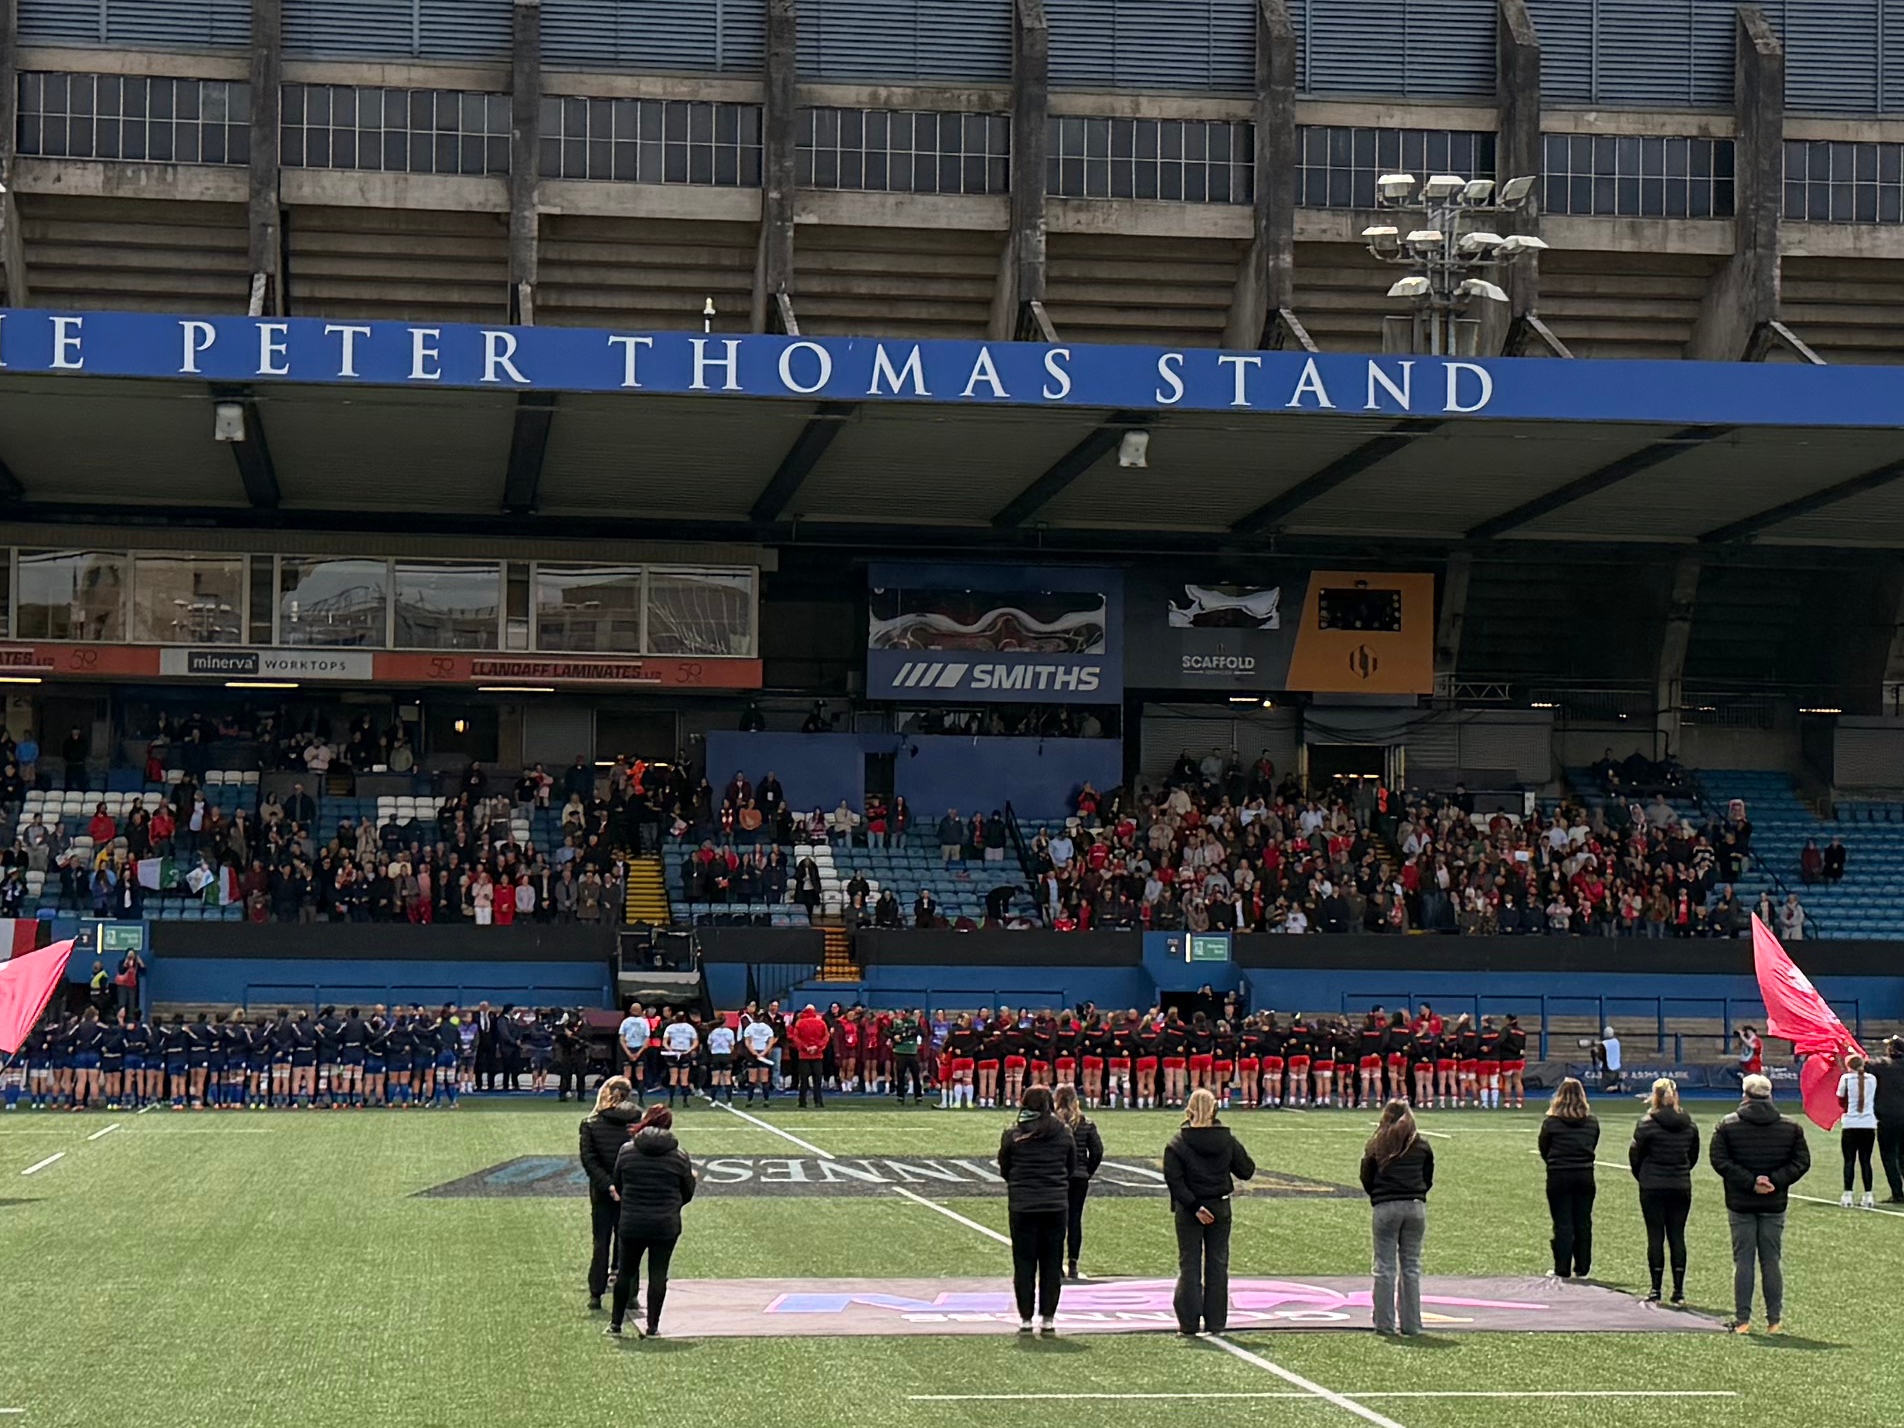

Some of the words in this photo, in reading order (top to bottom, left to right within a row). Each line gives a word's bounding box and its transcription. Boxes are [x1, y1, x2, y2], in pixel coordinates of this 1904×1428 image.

[178, 321, 531, 384] PETER
[608, 335, 1072, 400] THOMAS
[1155, 352, 1495, 413] STAND
[193, 655, 254, 670] minerva
[264, 659, 347, 672] WORKTOPS
[552, 663, 642, 680] LAMINATES
[1181, 655, 1256, 671] SCAFFOLD
[971, 664, 1100, 692] SMITHS
